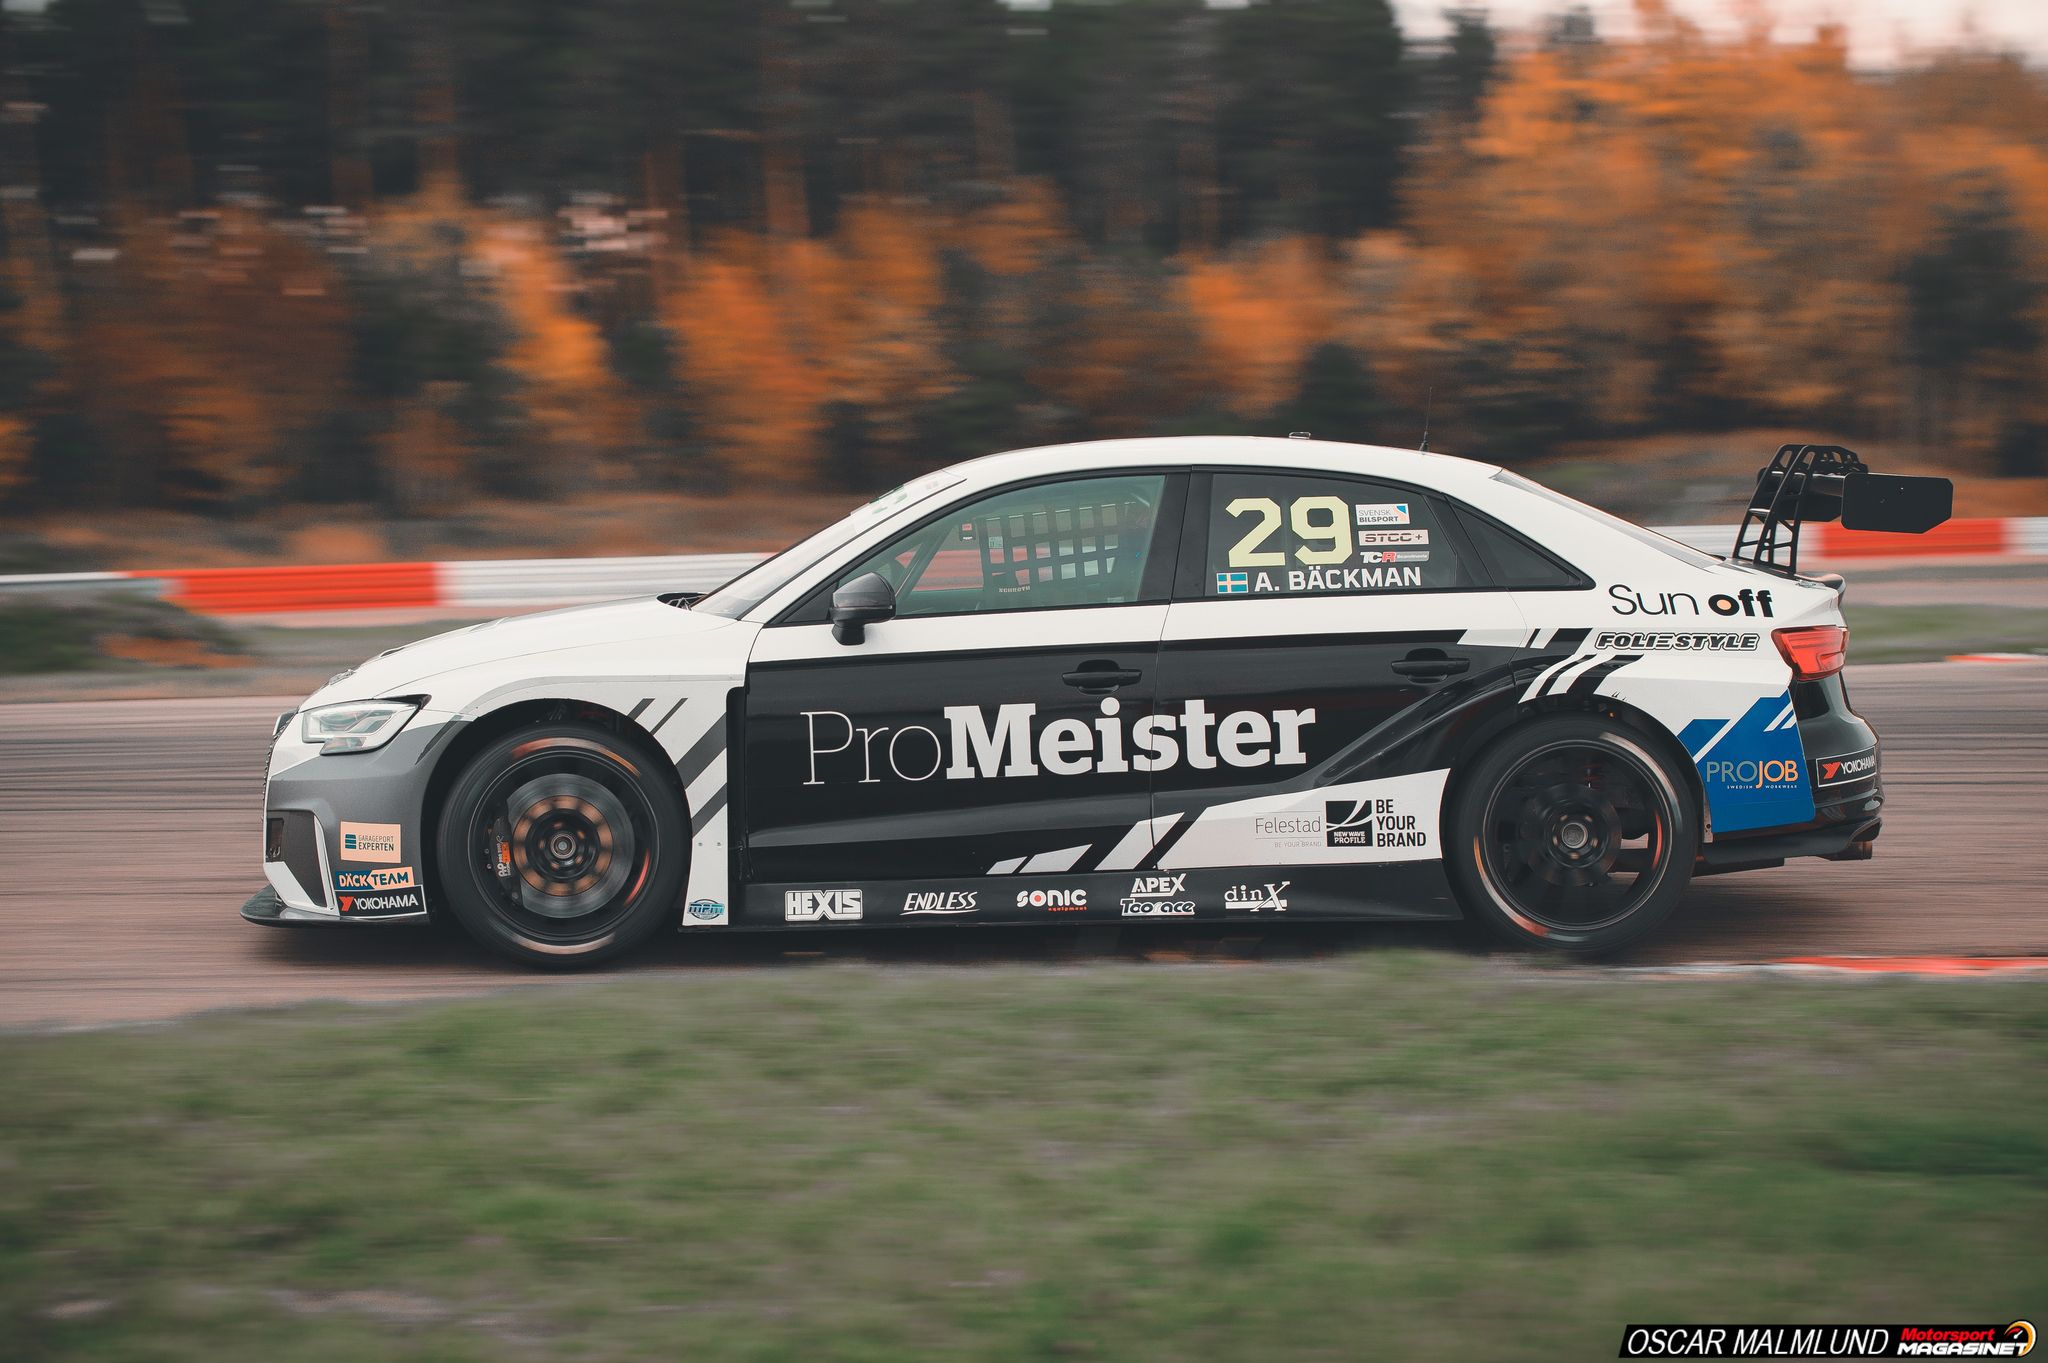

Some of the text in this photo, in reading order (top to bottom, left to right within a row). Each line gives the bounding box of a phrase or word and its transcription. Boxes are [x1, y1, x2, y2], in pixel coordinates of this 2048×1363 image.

[1358, 509, 1392, 517] SVENSK
[1225, 496, 1353, 568] 29
[1360, 551, 1397, 564] TCR
[1254, 566, 1421, 592] A. BÄCKMAN
[1608, 584, 1774, 618] Sun off
[1596, 632, 1760, 651] FOLIESTYLE
[799, 697, 1317, 786] ProMeister
[1840, 754, 1876, 775] YOKOHAMA
[1706, 760, 1799, 789] PROJOB
[1376, 800, 1394, 814] BE
[1255, 816, 1321, 834] Felestad
[1376, 815, 1415, 830] YOUR
[358, 834, 394, 842] GARAGEPORT
[358, 842, 395, 851] EXPERTEN
[1377, 832, 1427, 848] BRAND
[1131, 873, 1187, 893] APEX
[353, 894, 419, 910] YOKOHAMA
[786, 890, 862, 921] HEXIS
[903, 891, 978, 911] ENDLESS
[1223, 881, 1290, 912] dinX
